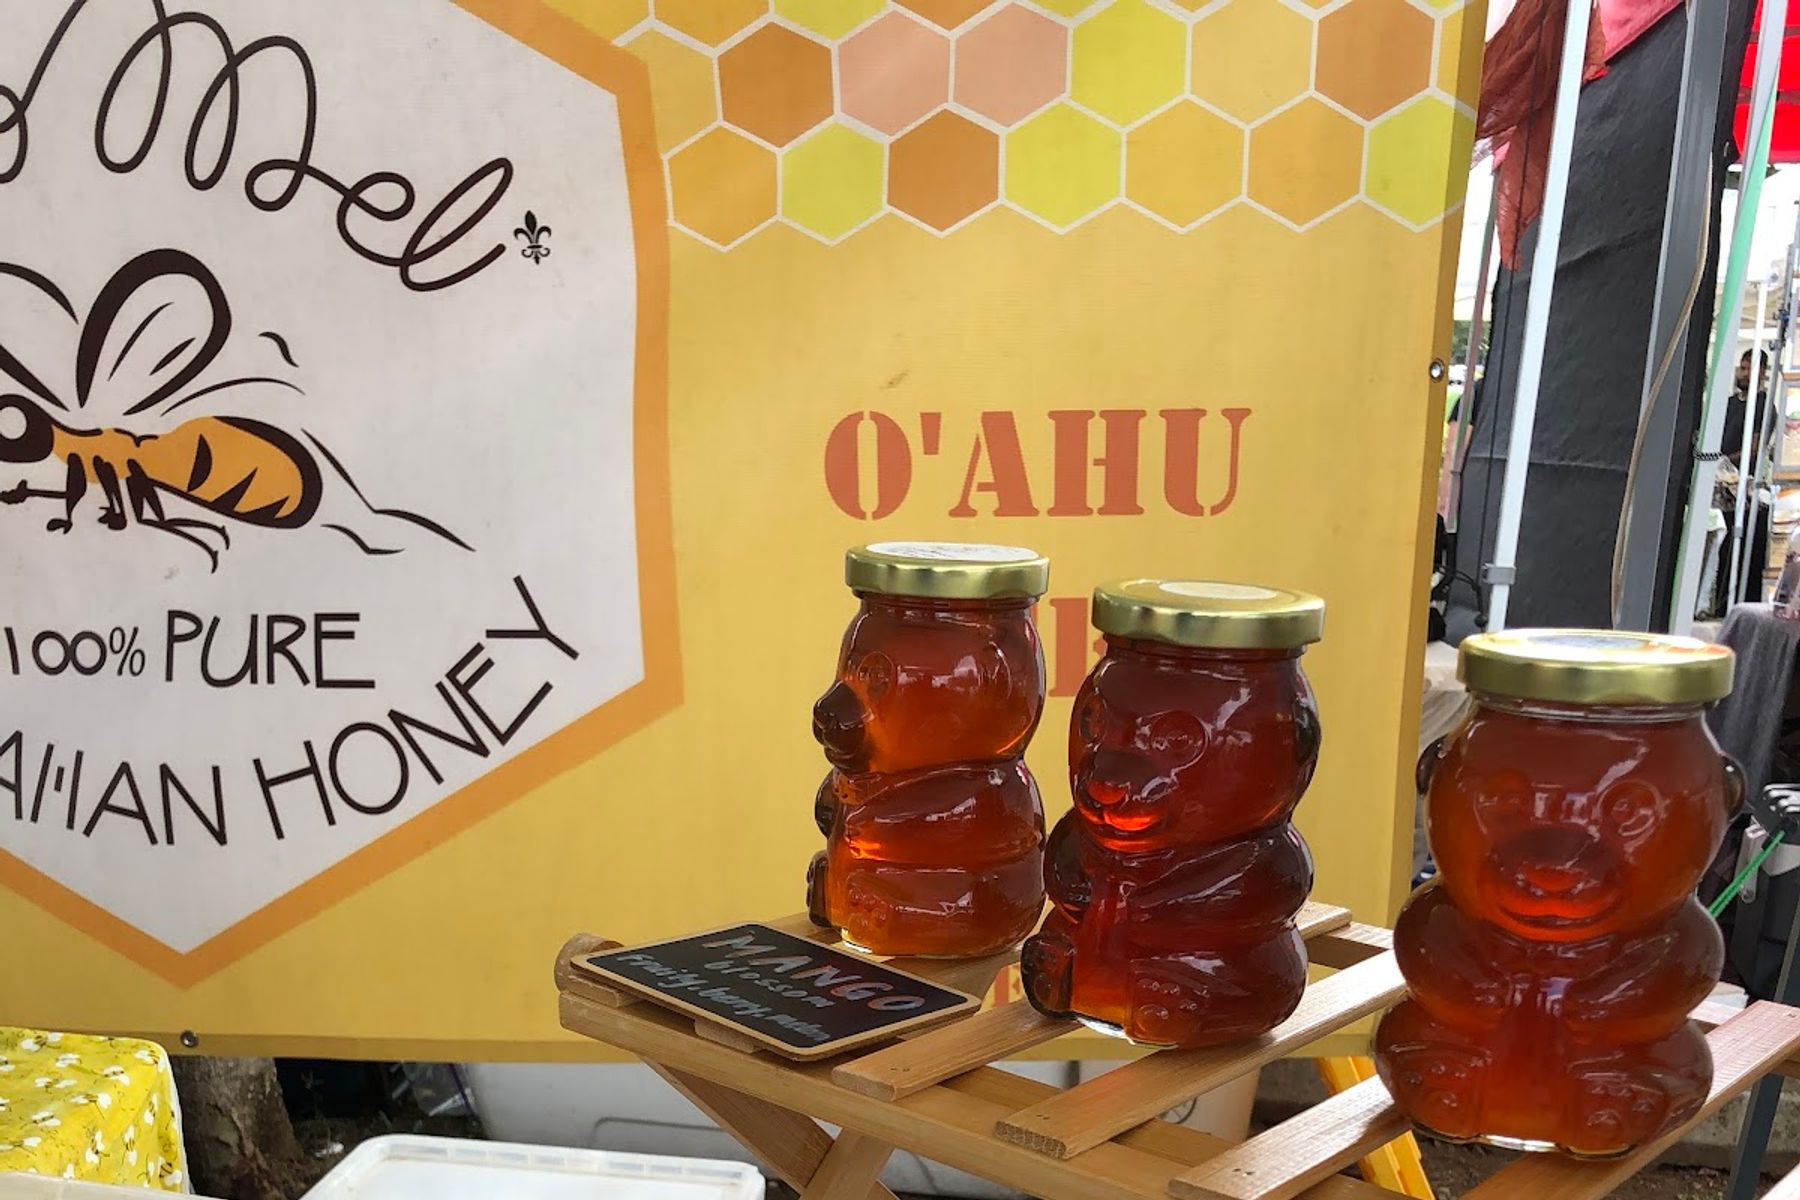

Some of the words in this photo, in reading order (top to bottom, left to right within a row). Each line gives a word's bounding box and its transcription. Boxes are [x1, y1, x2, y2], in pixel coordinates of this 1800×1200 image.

[824, 407, 1252, 521] O'AHU
[4, 626, 146, 677] 100%
[165, 610, 376, 689] PURE
[252, 575, 580, 840] HONEY
[702, 930, 926, 1012] MANGO
